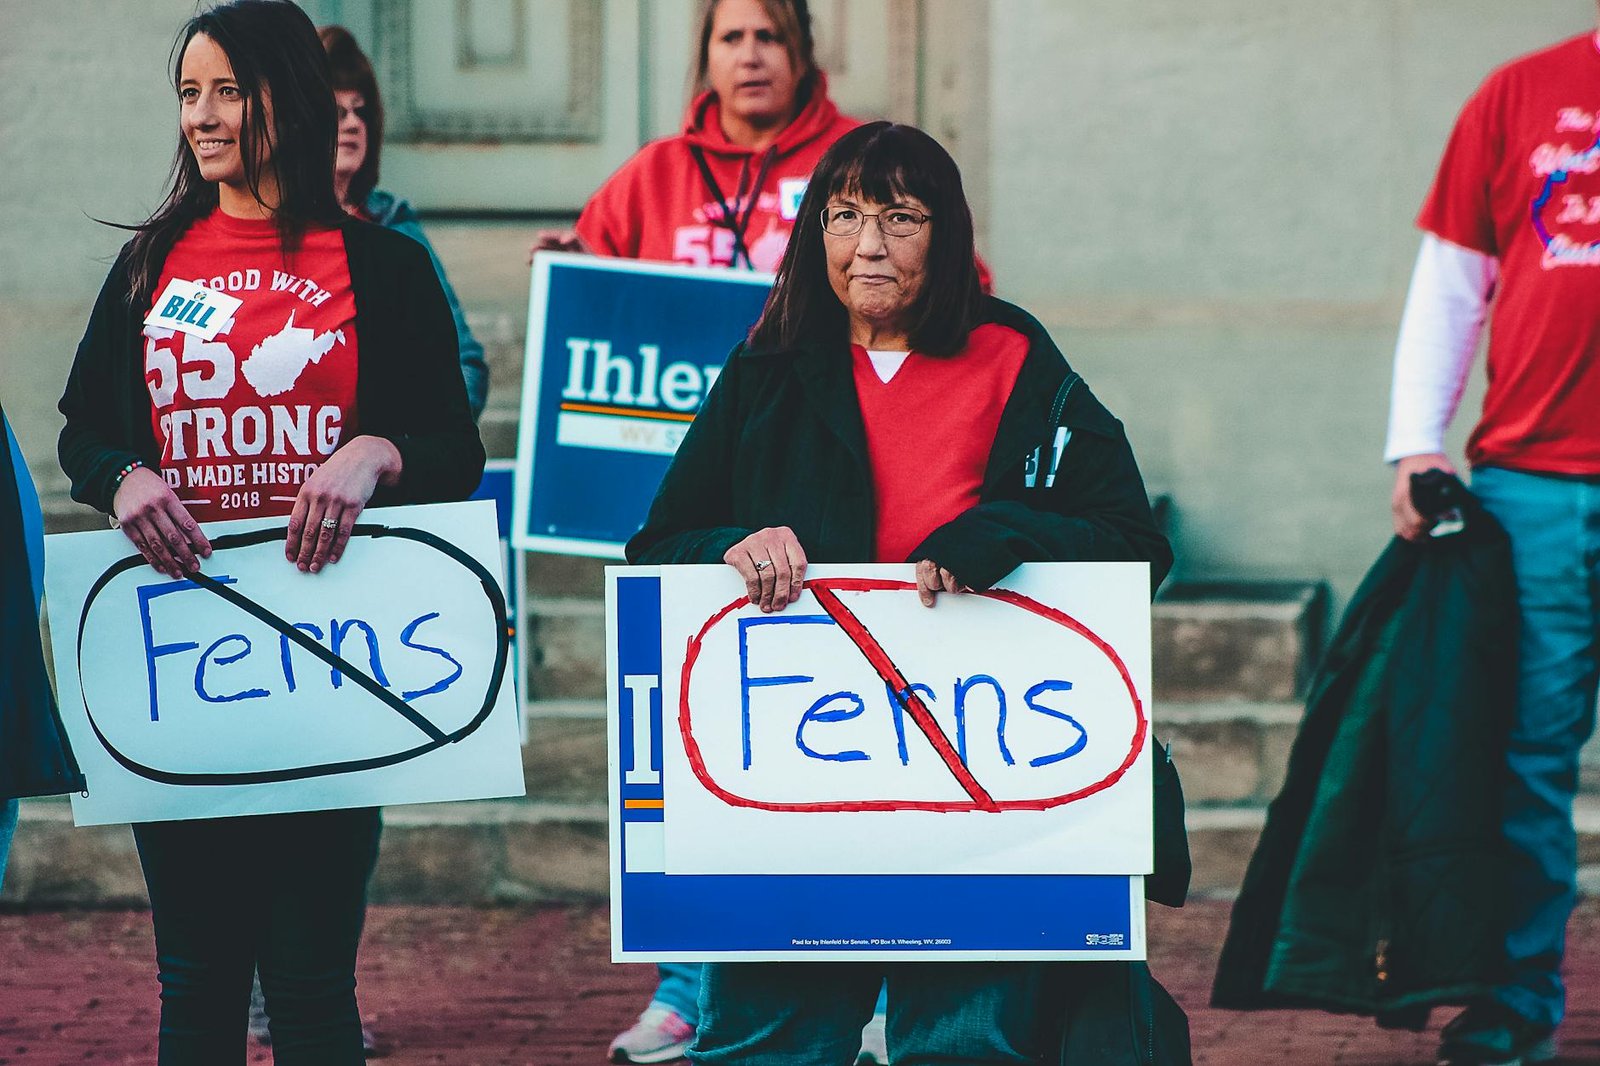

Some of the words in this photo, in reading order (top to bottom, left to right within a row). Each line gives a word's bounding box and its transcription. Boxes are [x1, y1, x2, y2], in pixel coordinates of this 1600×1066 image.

[270, 270, 332, 308] WITH
[160, 295, 216, 329] BILL
[145, 317, 236, 409] 55
[186, 464, 247, 488] MADE
[221, 492, 260, 509] 2018
[136, 575, 463, 722] Ferns
[737, 614, 1088, 771] Ferns
[812, 938, 819, 946] by
